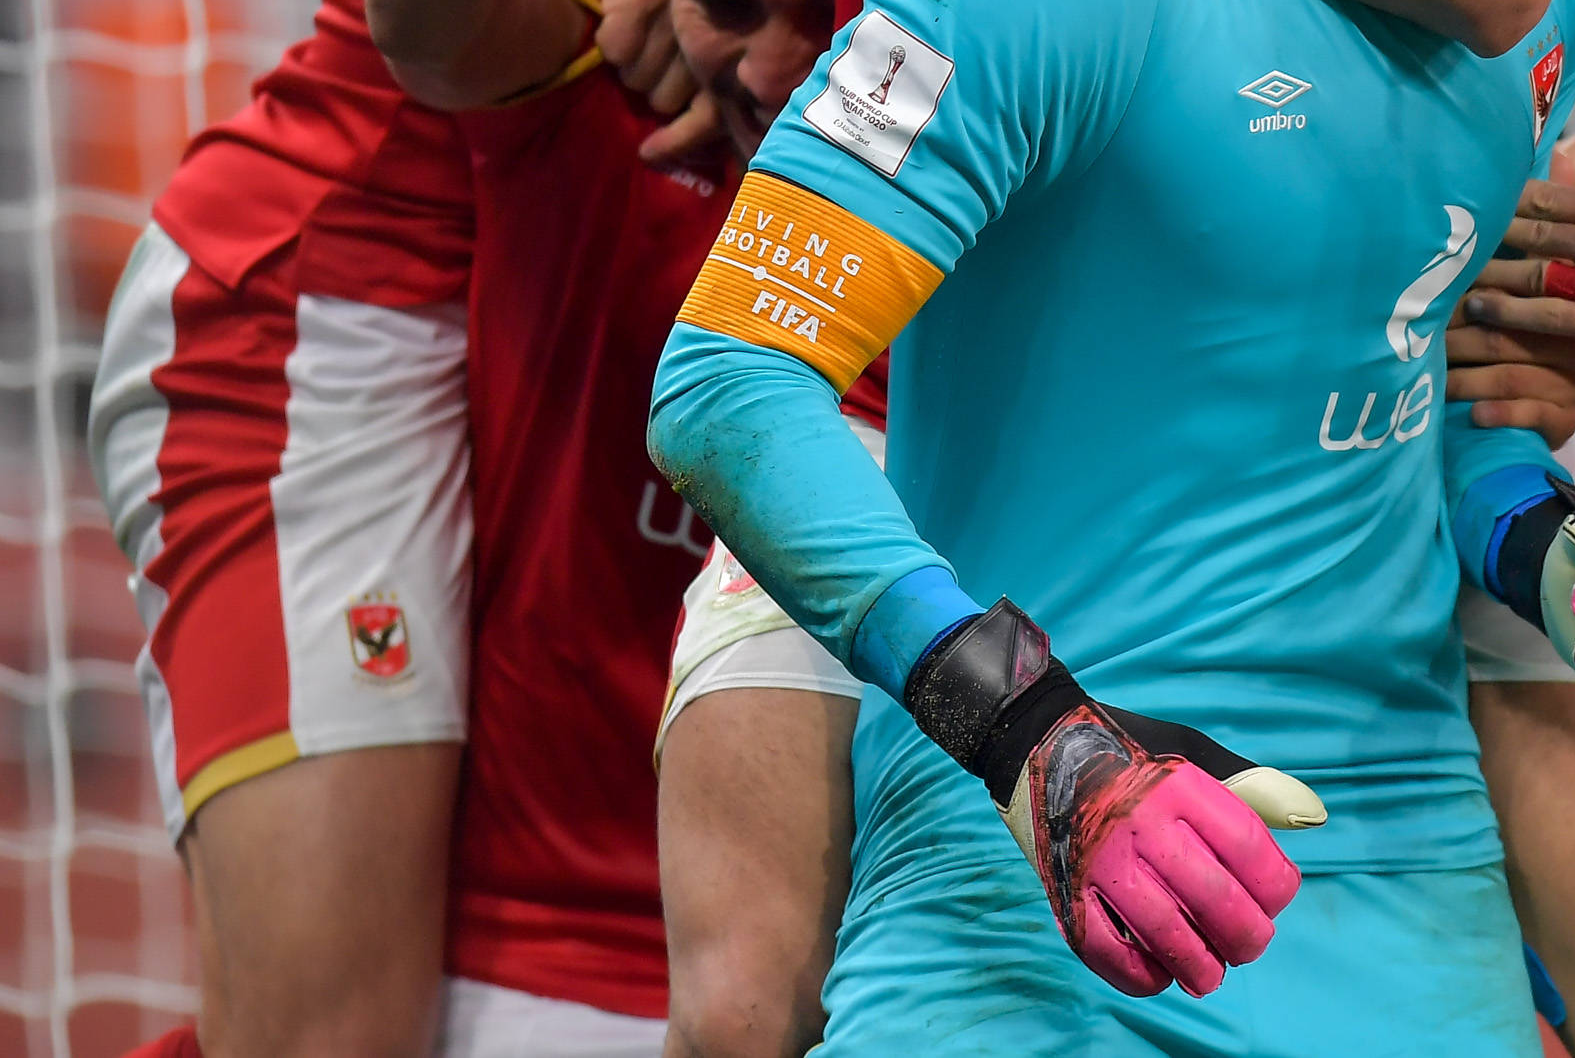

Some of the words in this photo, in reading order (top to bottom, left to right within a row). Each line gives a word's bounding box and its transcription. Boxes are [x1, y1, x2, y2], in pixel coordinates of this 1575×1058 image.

[839, 85, 857, 100] CLUB
[855, 96, 882, 116] WORLD
[881, 114, 898, 126] CUP
[841, 96, 865, 117] QATAR
[863, 112, 886, 131] 2020
[1249, 110, 1306, 133] umbro
[751, 289, 823, 343] FIFA
